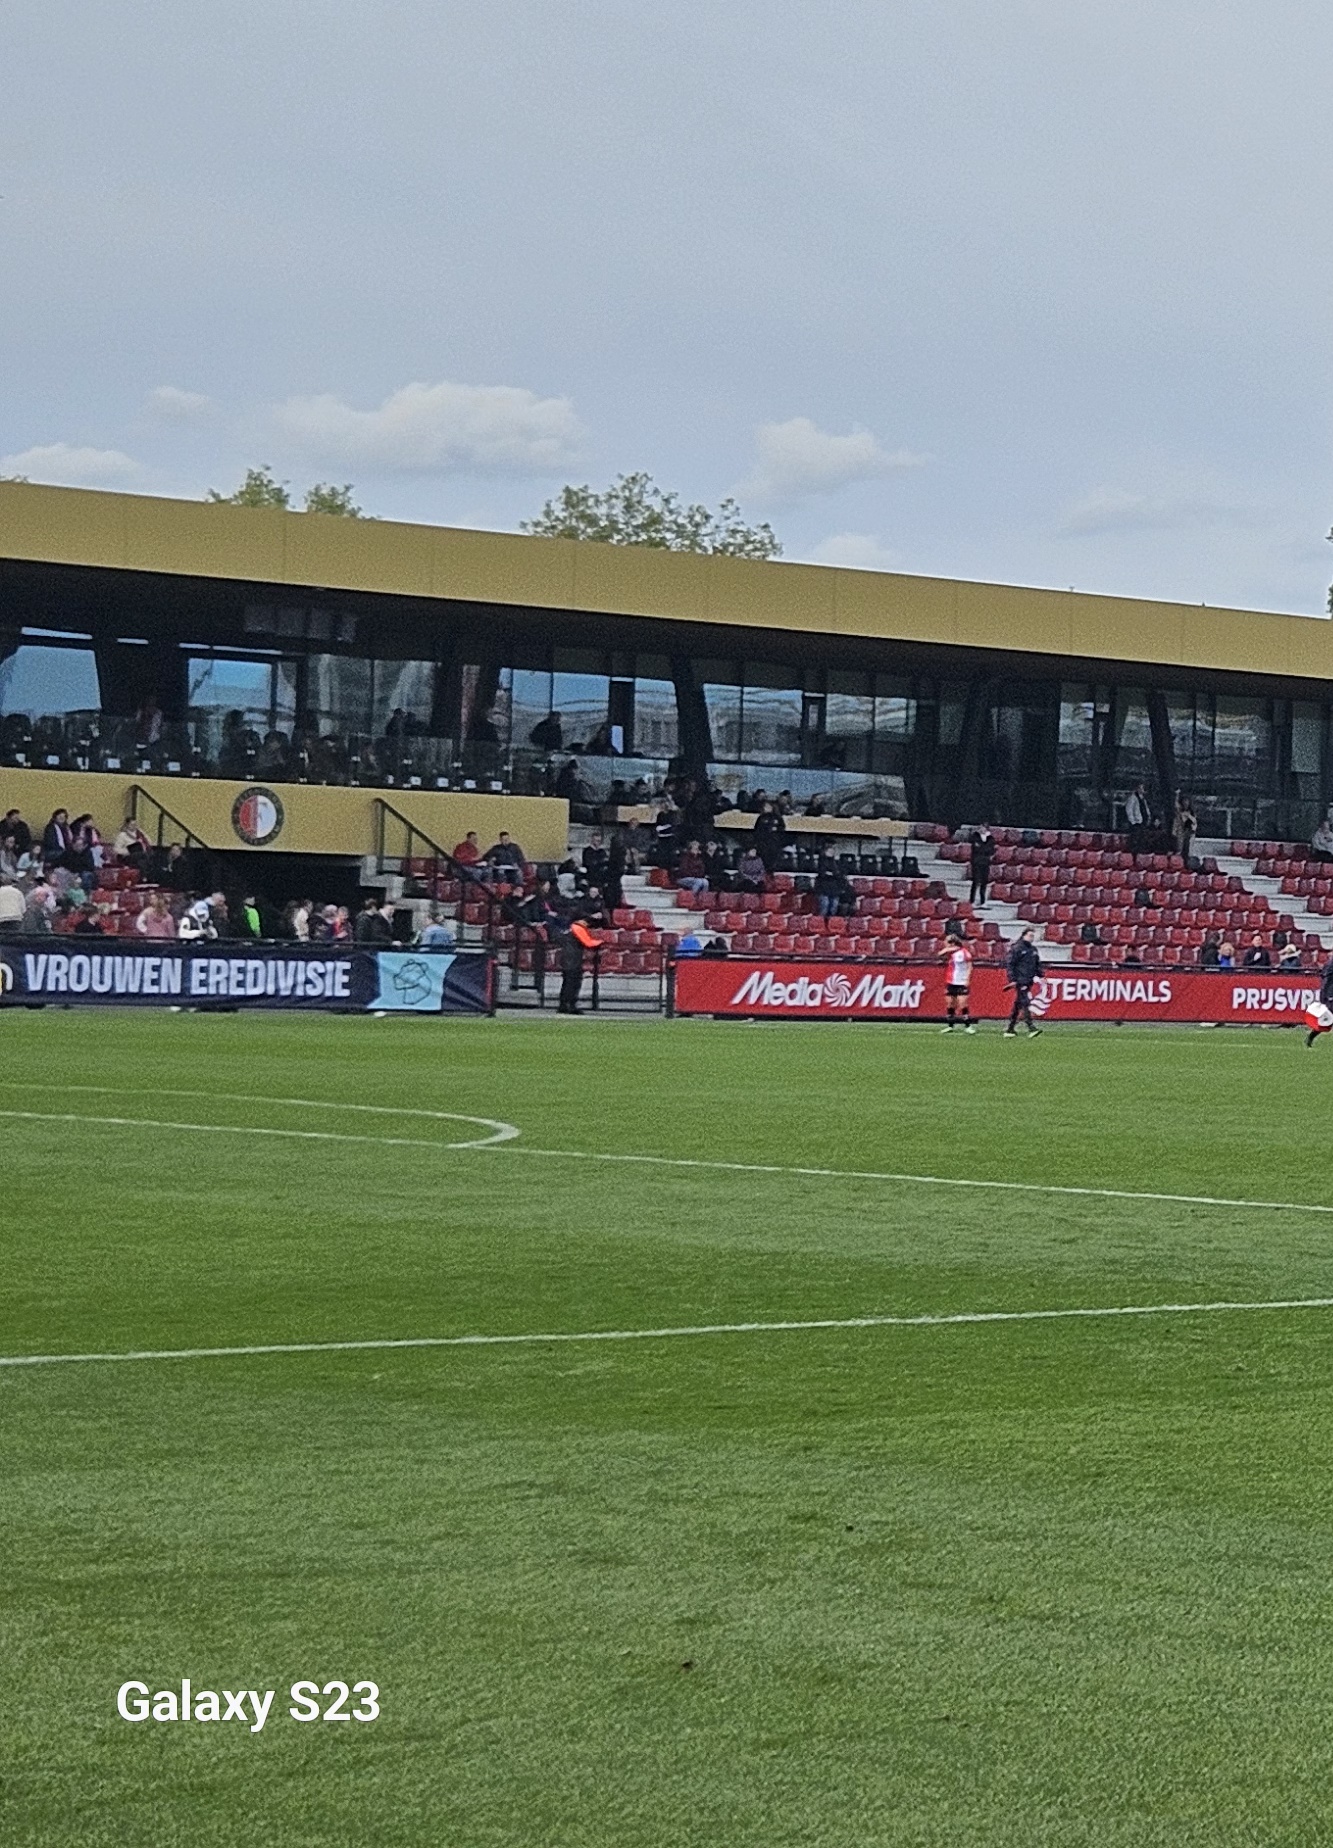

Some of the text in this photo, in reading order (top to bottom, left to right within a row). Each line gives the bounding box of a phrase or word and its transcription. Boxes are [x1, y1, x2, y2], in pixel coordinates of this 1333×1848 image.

[25, 953, 183, 994] VROUWEN
[189, 957, 351, 996] EREDIVISIE
[732, 971, 925, 1008] Media Markt
[1046, 978, 1172, 1002] TERMINALS
